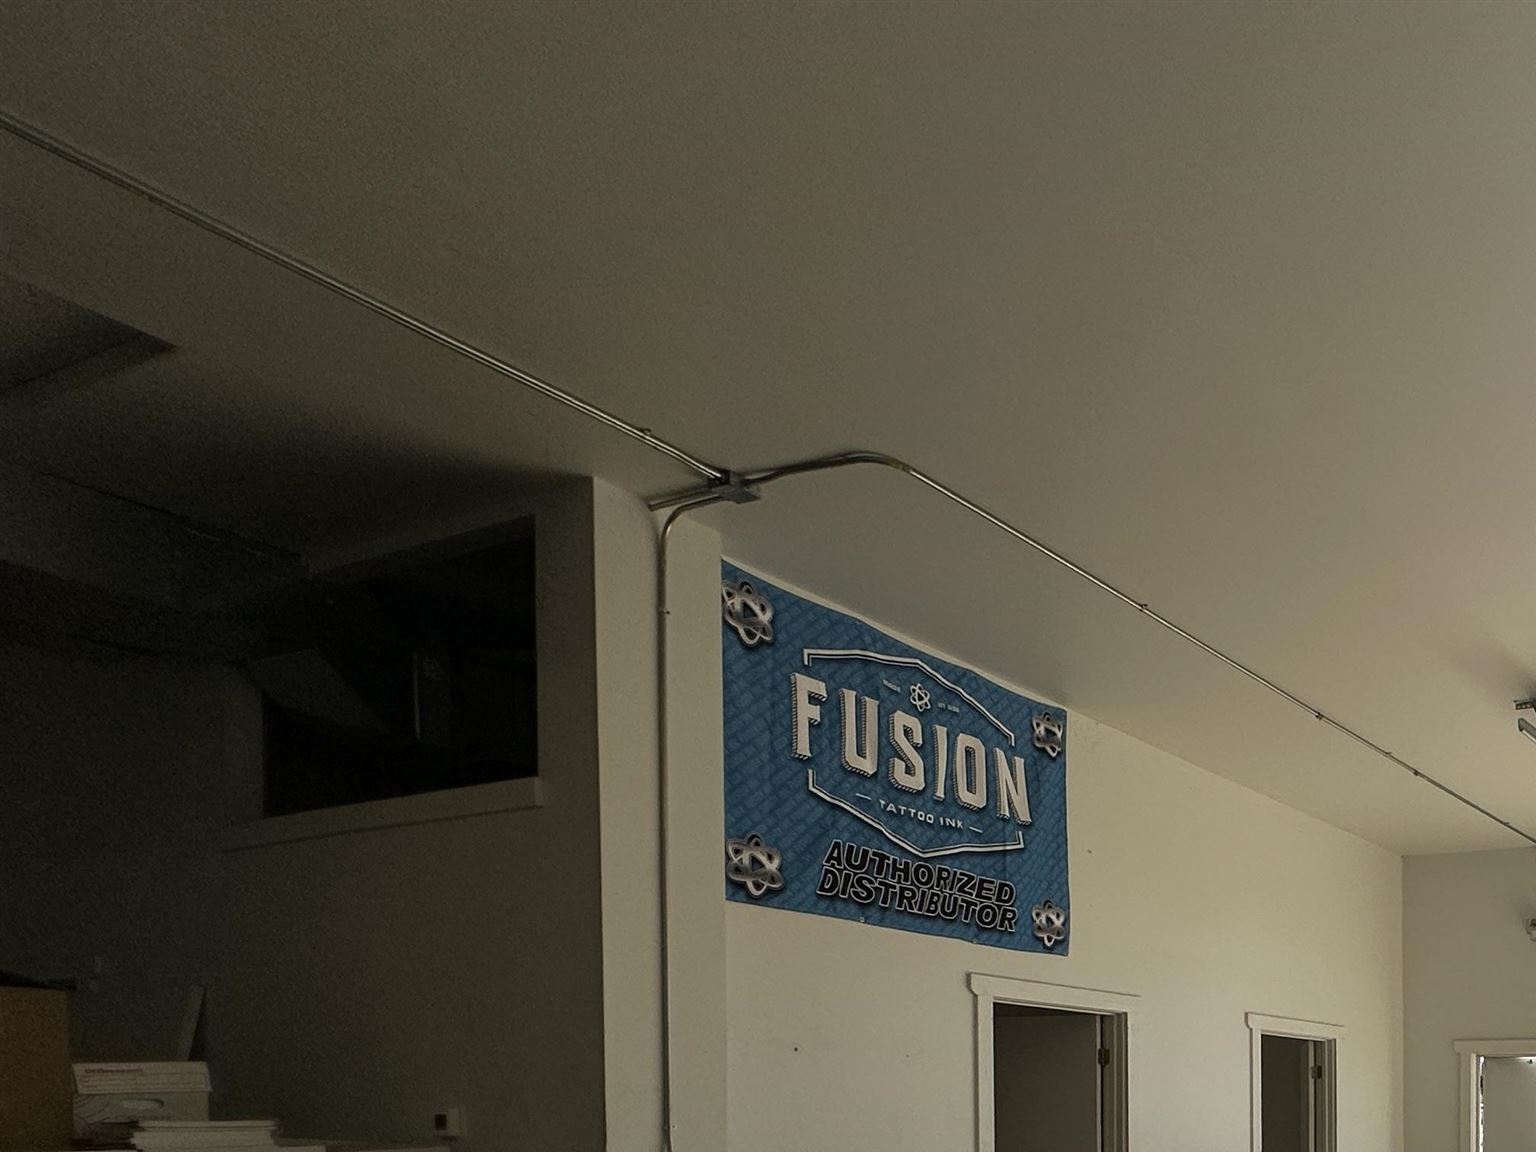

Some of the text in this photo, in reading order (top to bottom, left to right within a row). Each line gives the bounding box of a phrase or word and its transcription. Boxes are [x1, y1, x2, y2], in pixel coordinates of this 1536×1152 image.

[790, 672, 1032, 826] FUSION
[878, 799, 964, 829] TATTOO INK
[816, 866, 1018, 932] DISTRIBUTOR
[822, 839, 1016, 906] AUTHORIZED
